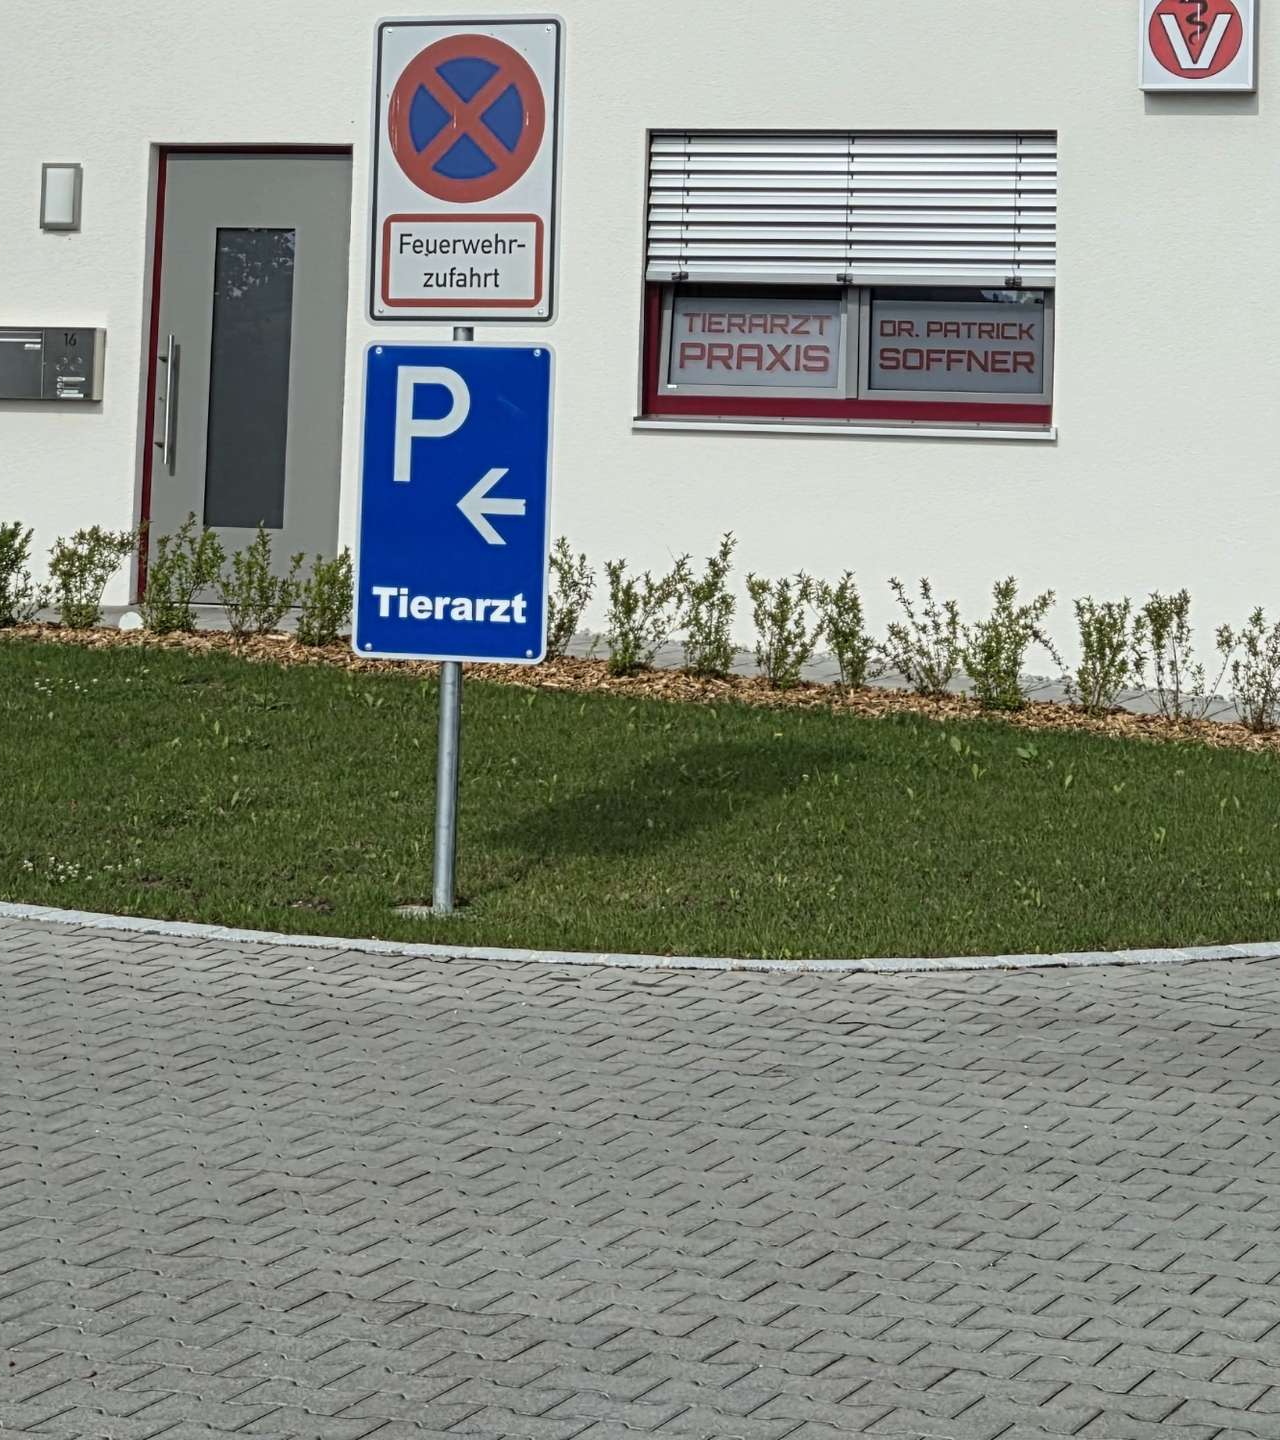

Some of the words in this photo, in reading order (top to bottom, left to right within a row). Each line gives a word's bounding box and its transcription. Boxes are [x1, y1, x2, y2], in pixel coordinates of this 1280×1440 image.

[399, 233, 526, 255] Feuerwehr-
[423, 267, 500, 288] zufahrt
[682, 313, 833, 336] TIERARZT
[880, 320, 919, 338] DR.
[927, 321, 1035, 340] PATRICK
[64, 333, 77, 346] 16
[679, 342, 830, 372] PRAXIS
[879, 348, 1035, 373] SOFFNER
[393, 366, 470, 482] P
[372, 586, 527, 624] Tierarzt
